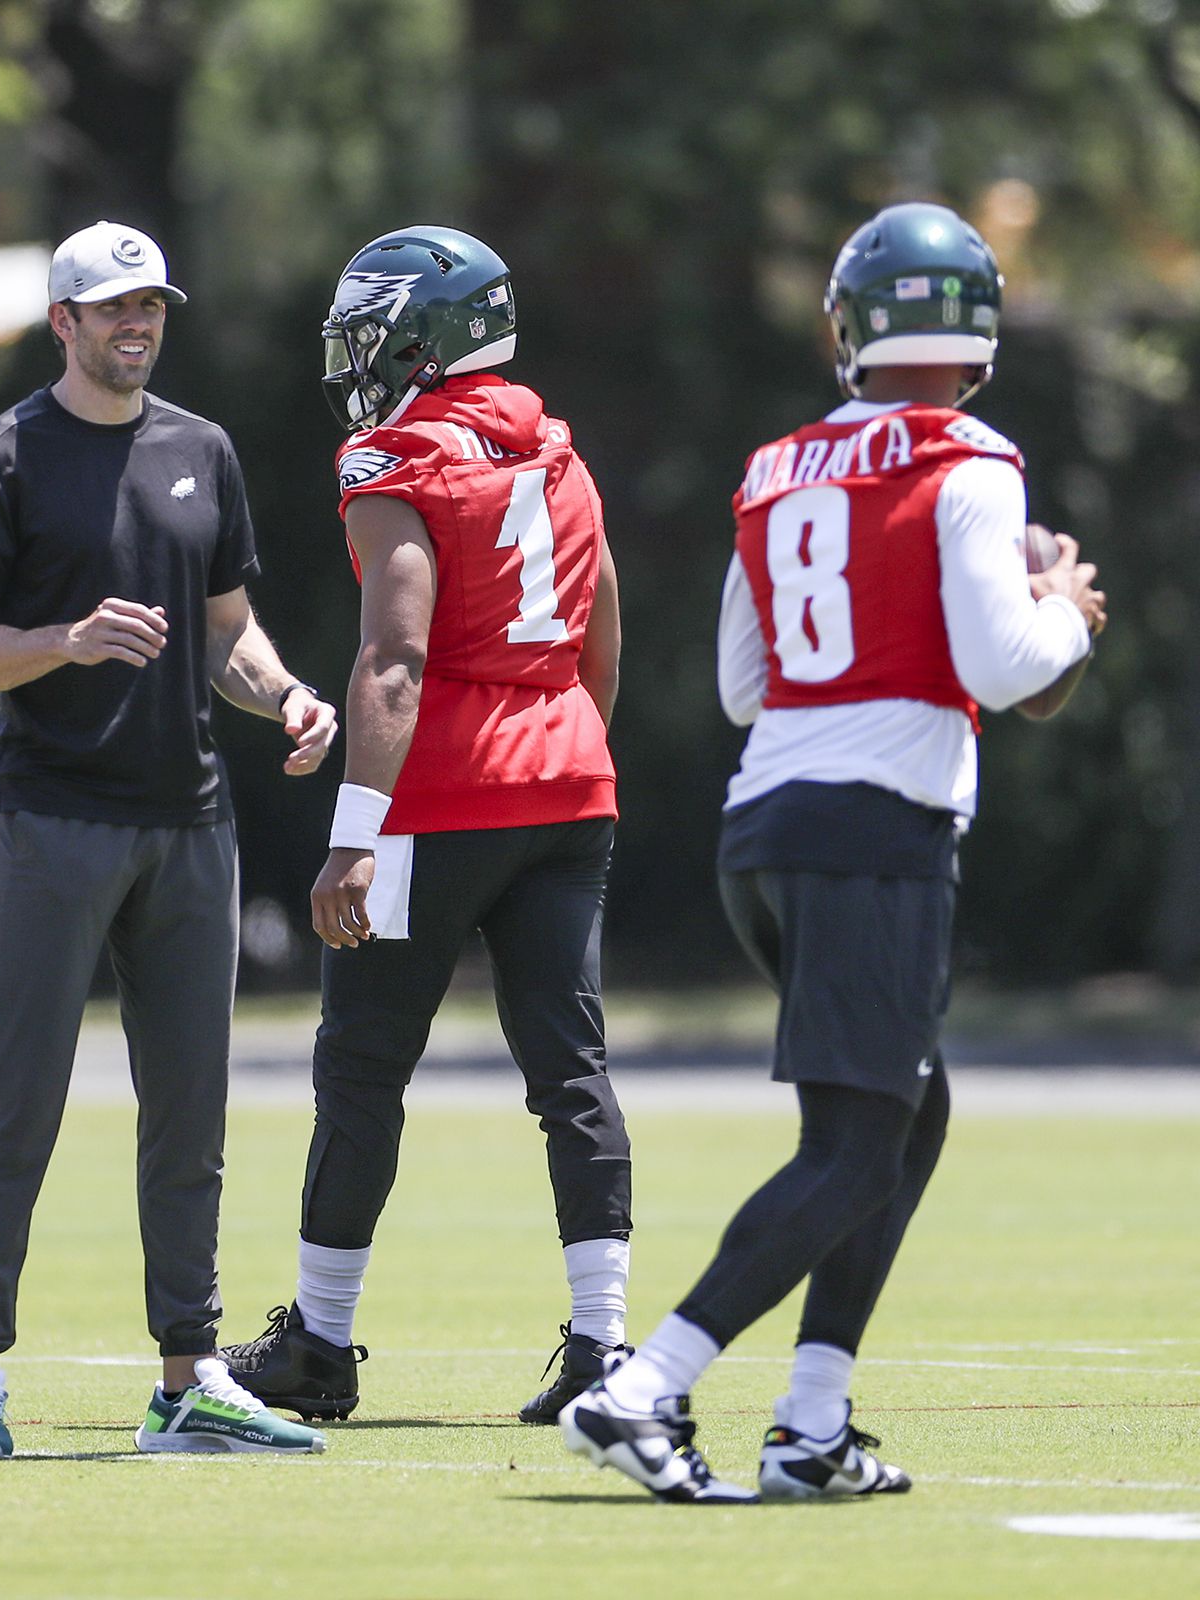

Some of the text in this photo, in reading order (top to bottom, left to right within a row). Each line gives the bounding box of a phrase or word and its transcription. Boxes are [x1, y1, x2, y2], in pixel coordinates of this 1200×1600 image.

[443, 422, 567, 460] HUS
[494, 467, 570, 643] 1
[767, 484, 856, 684] 8
